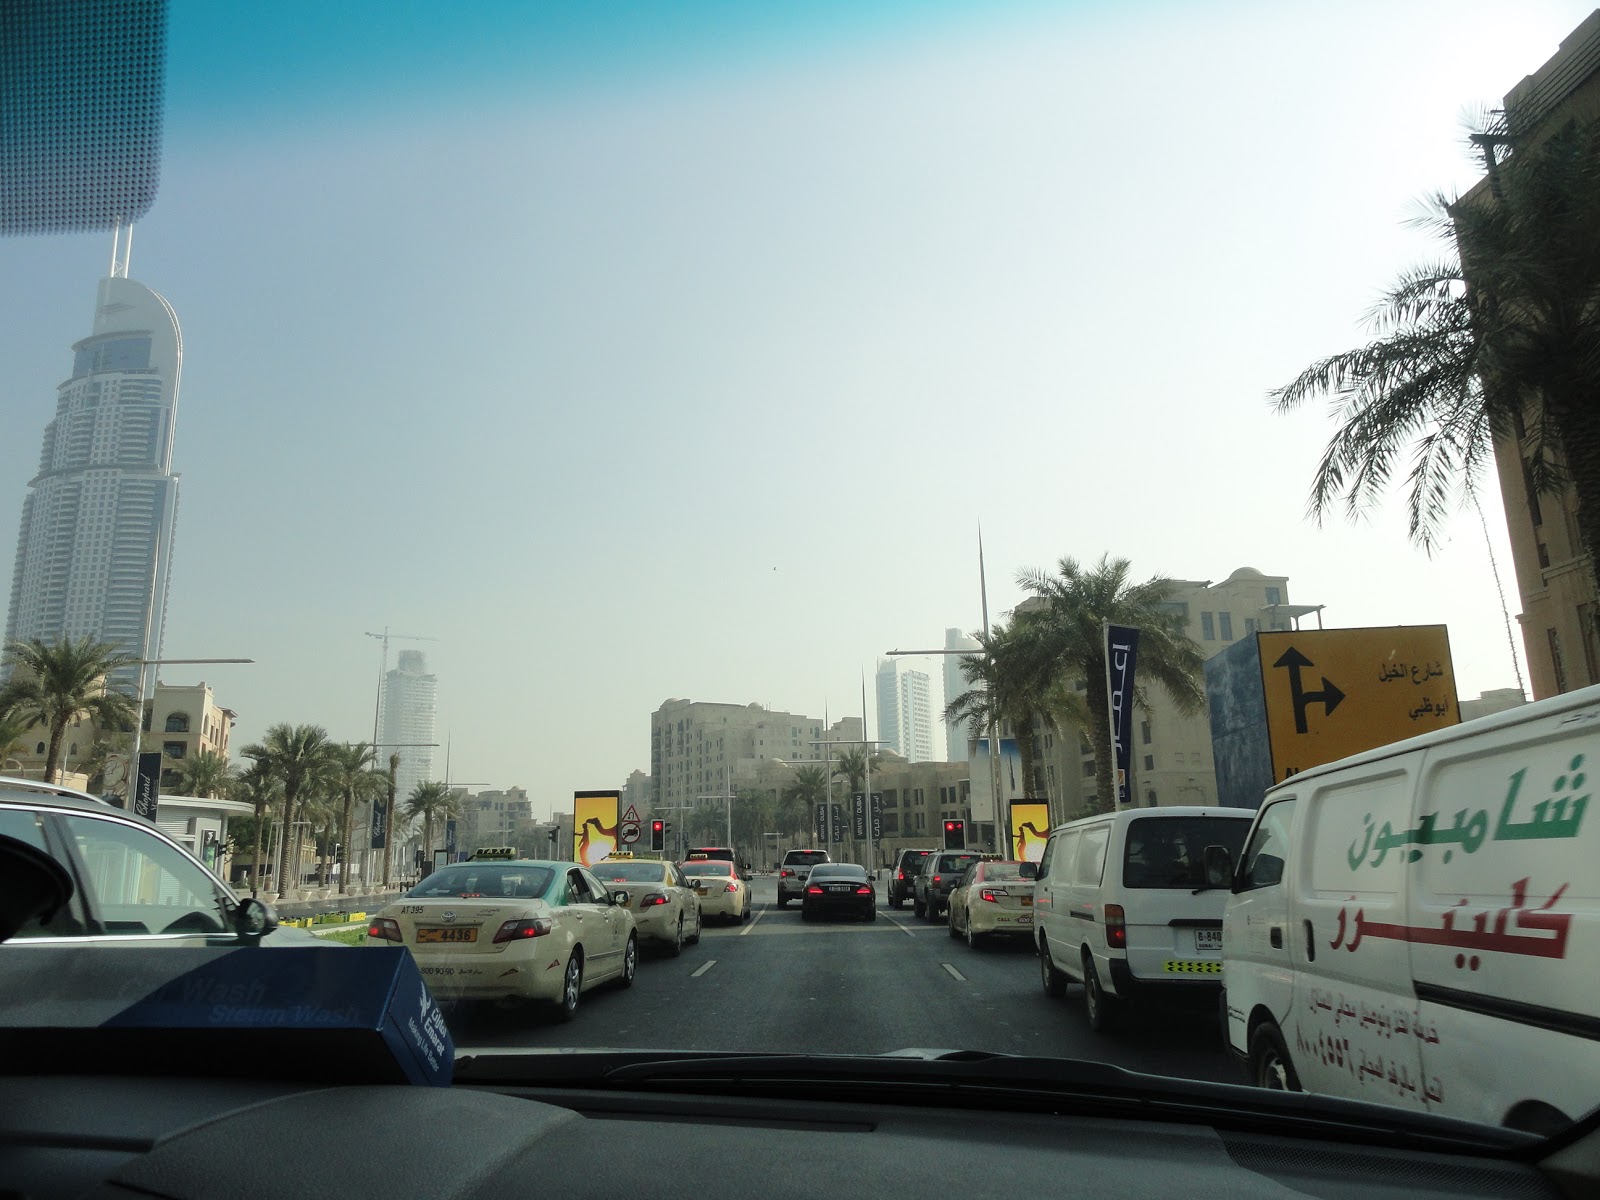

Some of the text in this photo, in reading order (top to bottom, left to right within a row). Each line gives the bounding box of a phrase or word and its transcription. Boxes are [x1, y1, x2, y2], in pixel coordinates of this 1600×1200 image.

[1379, 661, 1443, 684] شارع الخيل
[135, 773, 151, 816] Chopard
[1348, 753, 1592, 871] شامبيون
[401, 906, 424, 914] AT 395
[441, 930, 471, 941] 4436
[1330, 877, 1574, 971] كلينرز
[436, 967, 445, 975] 90
[446, 967, 455, 975] 90
[183, 976, 266, 1003] Wash
[208, 1004, 361, 1025] Steam Wash
[424, 1017, 445, 1057] Emarat
